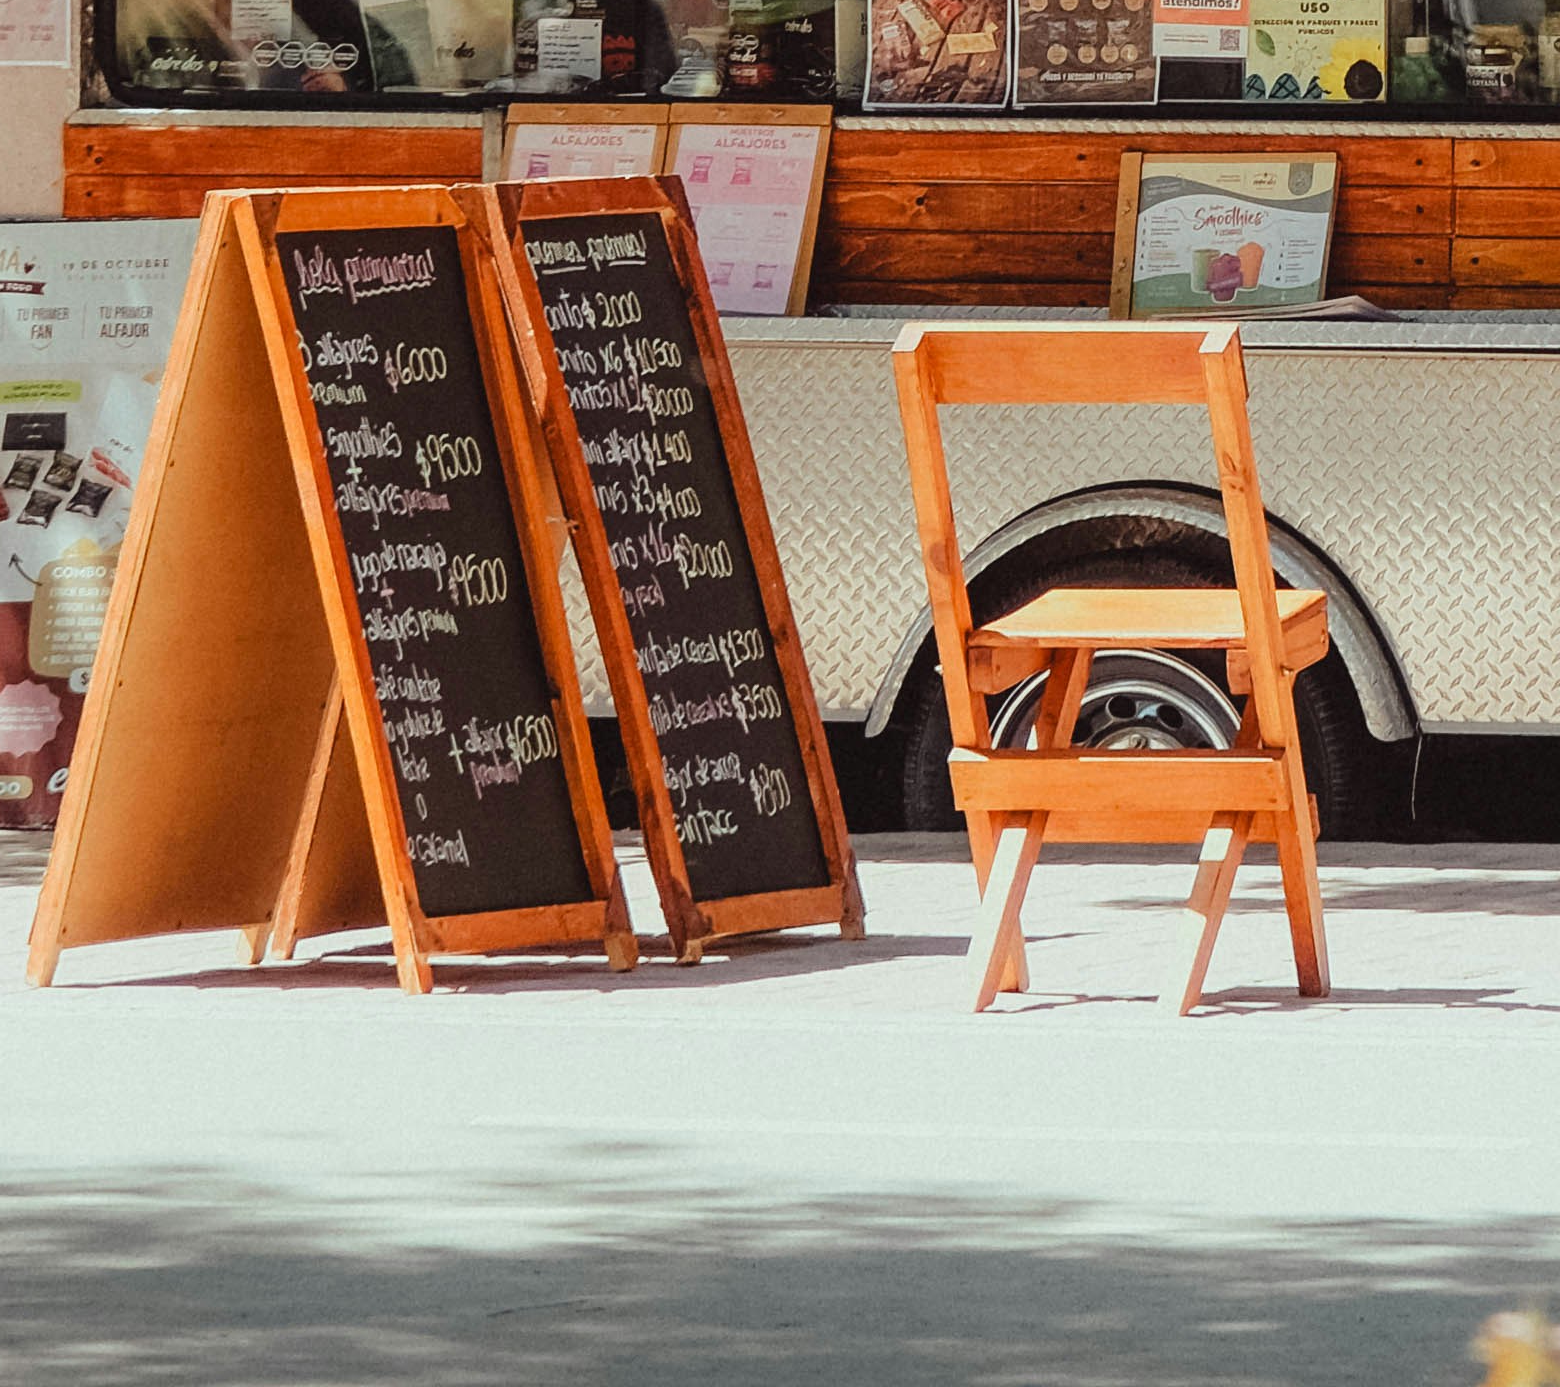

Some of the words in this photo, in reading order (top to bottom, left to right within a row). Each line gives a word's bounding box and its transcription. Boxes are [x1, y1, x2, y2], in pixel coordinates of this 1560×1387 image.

[1300, 2, 1330, 13] USO
[551, 134, 624, 147] ALFAJORES
[713, 137, 787, 149] ALFAJORES
[1192, 205, 1265, 231] Smoothies
[17, 308, 30, 320] TU
[99, 307, 112, 319] TU
[30, 326, 53, 340] FAN
[99, 322, 150, 339] ALFAJOR
[623, 333, 682, 377] $10500
[384, 342, 448, 394] $6000
[415, 433, 482, 488] $9500
[448, 553, 508, 607] $9500
[719, 628, 766, 678] $1300
[506, 715, 558, 775] $6500
